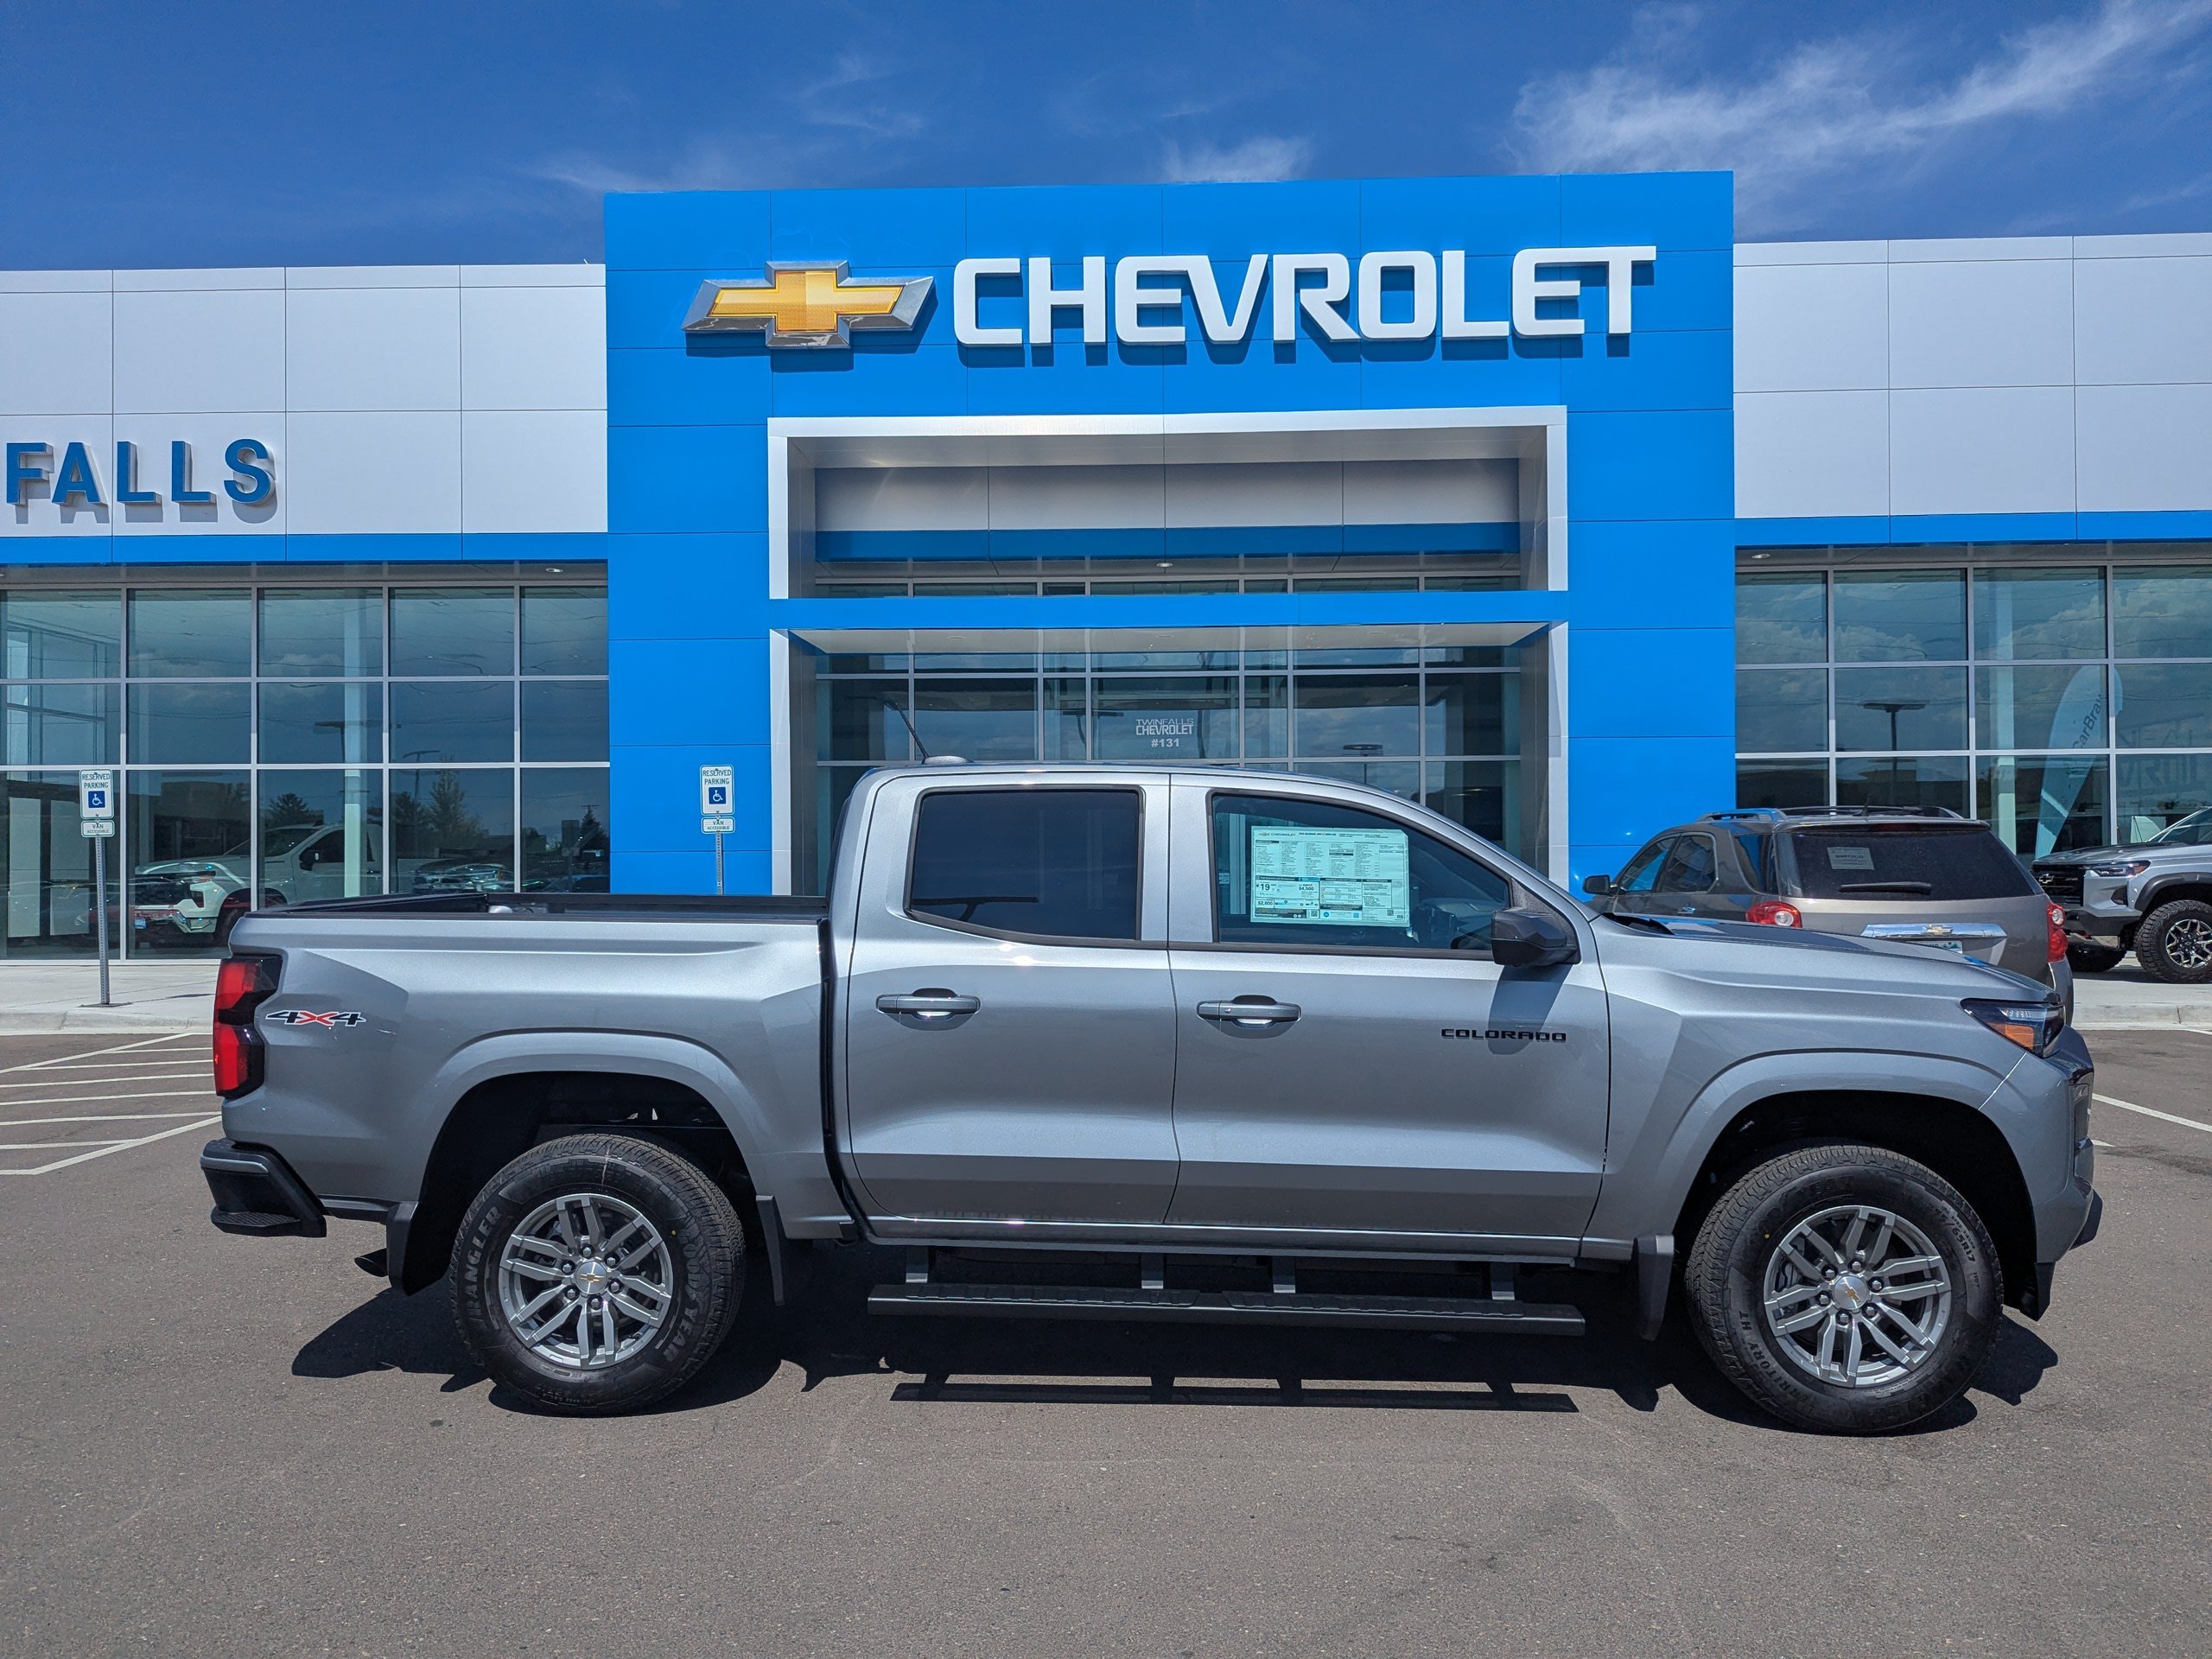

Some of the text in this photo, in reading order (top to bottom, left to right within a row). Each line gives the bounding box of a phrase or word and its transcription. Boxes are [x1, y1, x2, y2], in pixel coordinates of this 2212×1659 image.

[953, 245, 1656, 346] CHEVROLET
[6, 438, 276, 505] FALLS
[1135, 725, 1194, 735] CHEVROLET
[1151, 738, 1179, 747] #131
[1441, 1028, 1567, 1043] COLORADO
